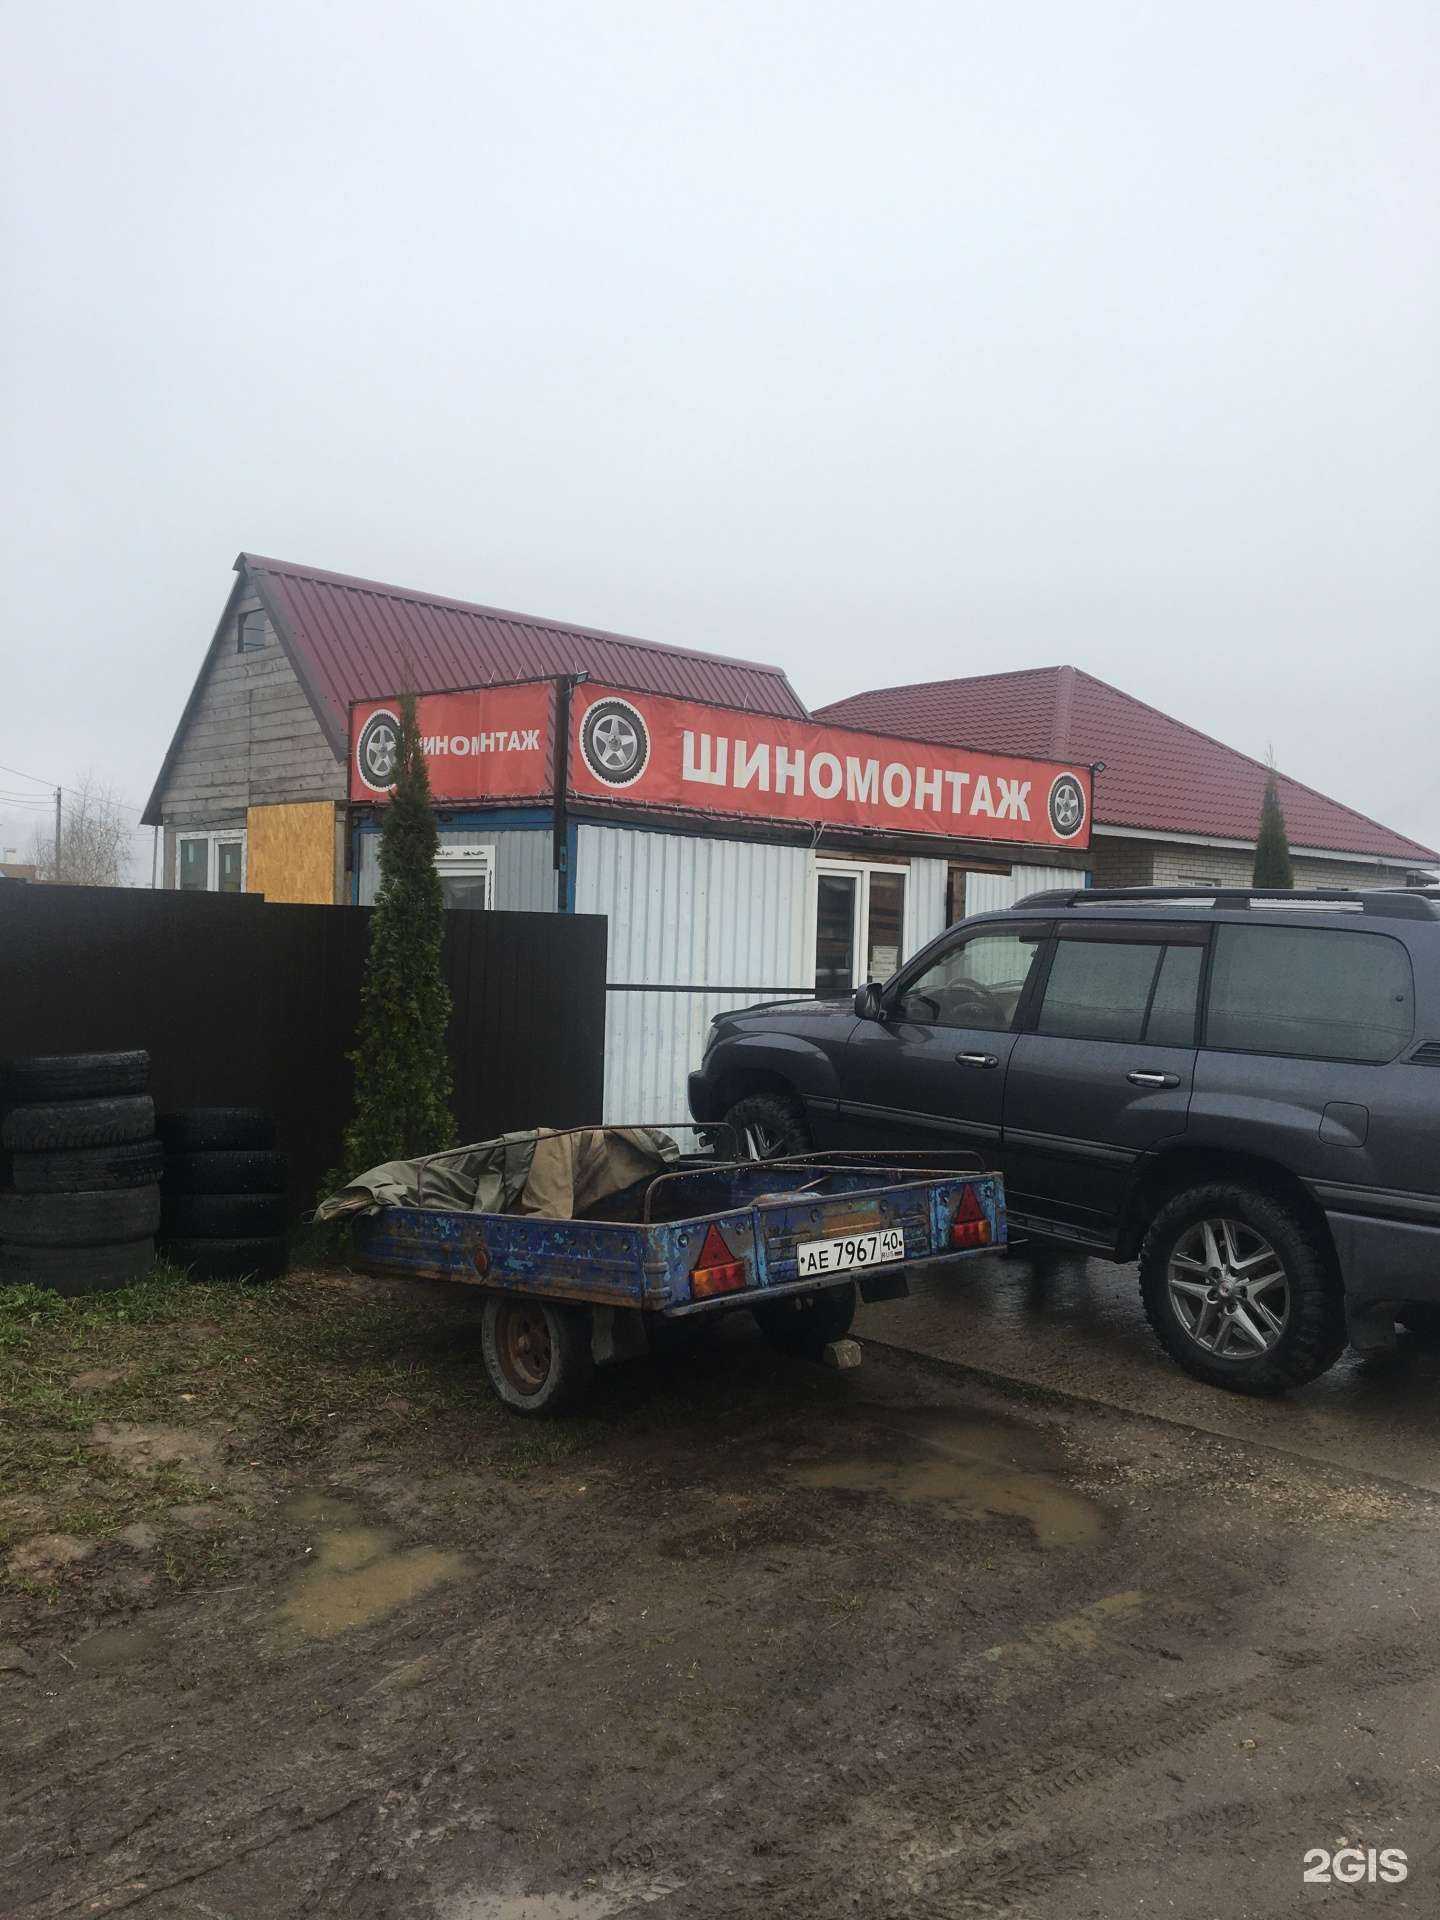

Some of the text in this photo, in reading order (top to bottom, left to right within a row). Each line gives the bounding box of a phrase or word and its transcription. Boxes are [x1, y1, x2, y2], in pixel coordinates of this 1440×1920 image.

[682, 730, 1032, 822] ШИНОМОНТАЖ
[833, 1236, 877, 1266] 7967
[882, 1232, 898, 1251] 40
